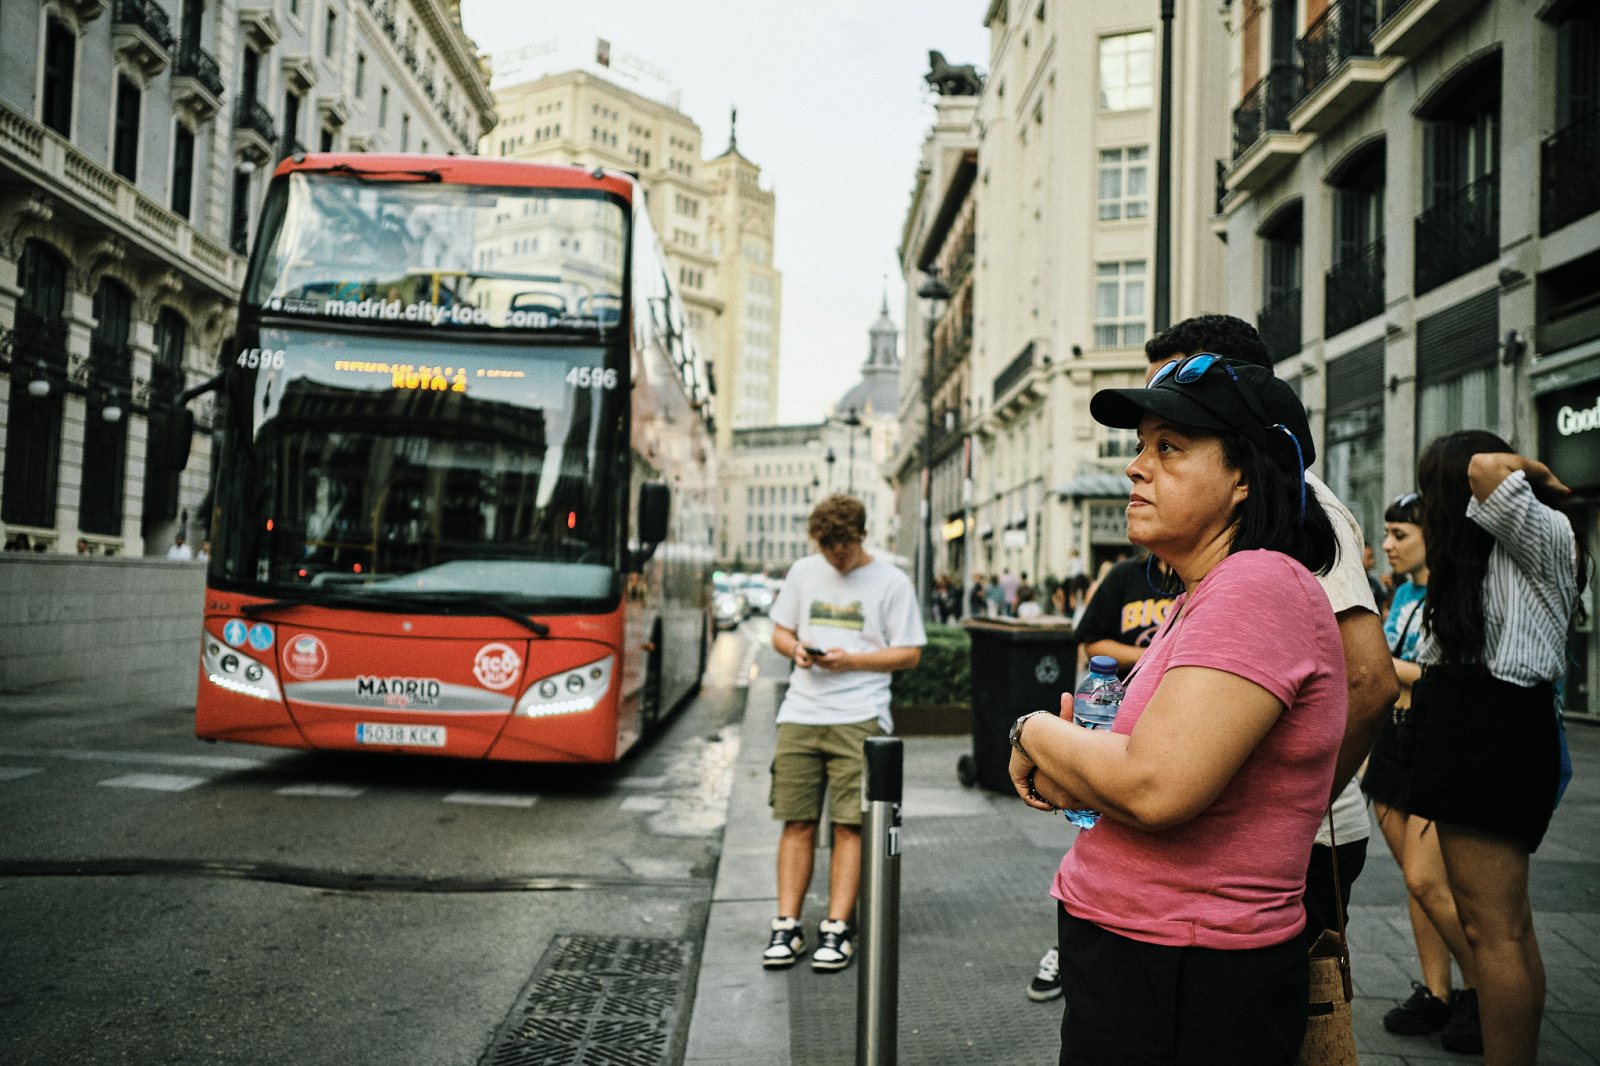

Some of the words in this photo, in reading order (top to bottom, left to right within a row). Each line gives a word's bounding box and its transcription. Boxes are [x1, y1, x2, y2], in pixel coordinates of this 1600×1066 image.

[236, 348, 286, 370] 4596
[565, 366, 618, 390] 4596
[357, 677, 441, 698] MADRID
[409, 727, 439, 743] KCK
